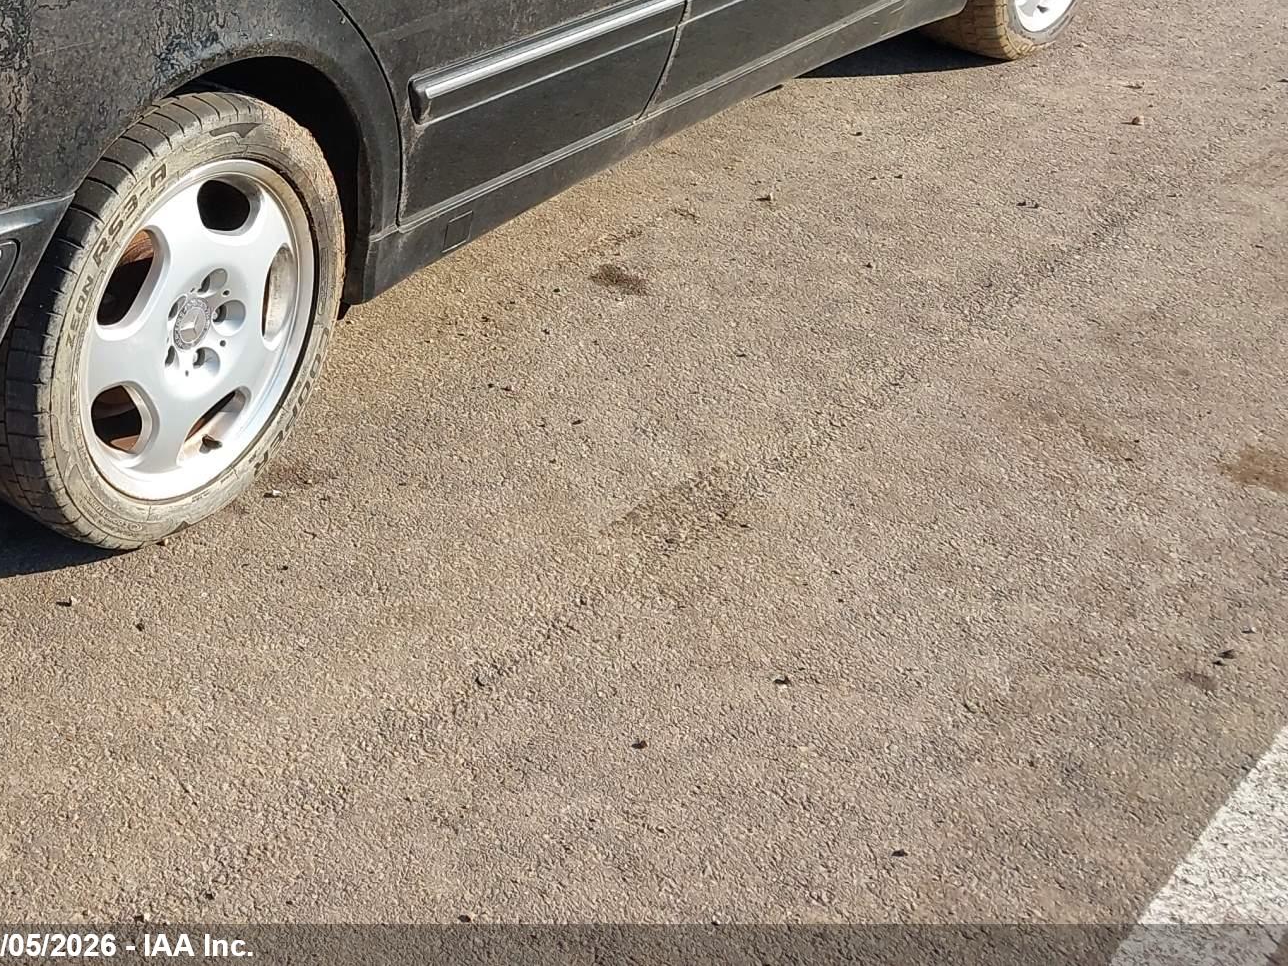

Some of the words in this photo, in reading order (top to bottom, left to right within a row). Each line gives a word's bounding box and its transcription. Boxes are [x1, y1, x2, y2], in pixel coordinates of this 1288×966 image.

[65, 275, 94, 349] ZEON
[92, 163, 167, 268] RS3-A
[254, 327, 329, 477] COOPER
